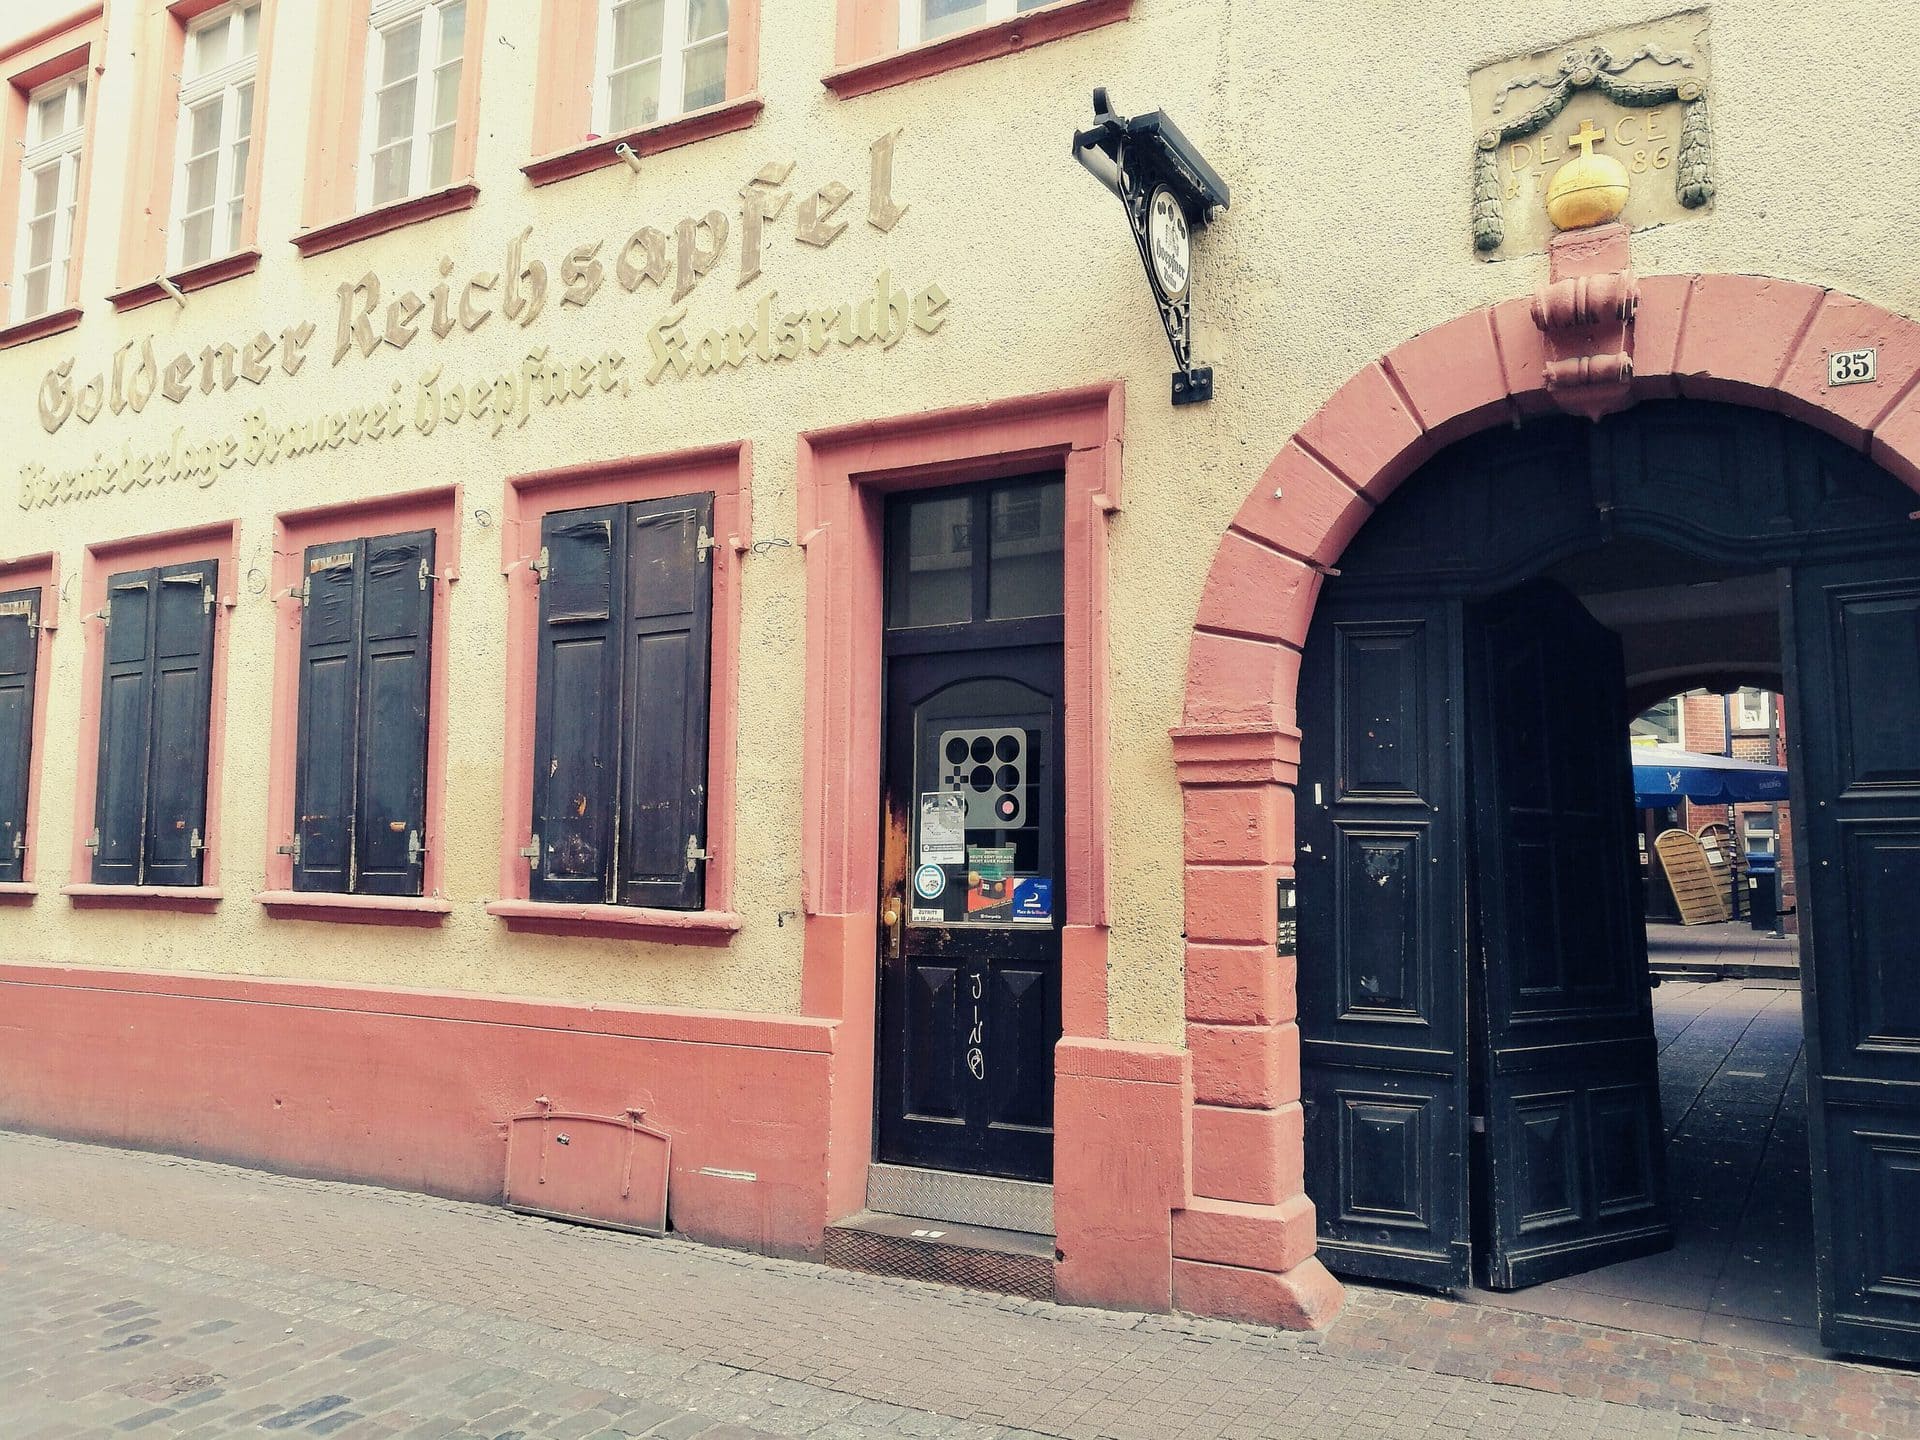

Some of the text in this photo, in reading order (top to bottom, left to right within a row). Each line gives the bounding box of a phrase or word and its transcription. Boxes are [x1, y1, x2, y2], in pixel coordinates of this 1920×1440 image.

[1631, 145, 1671, 175] 86
[37, 127, 910, 435] Goldener Reichsapfel
[243, 378, 404, 466] Brauerei
[645, 267, 951, 387] Karlsruhe
[1836, 352, 1870, 379] 35
